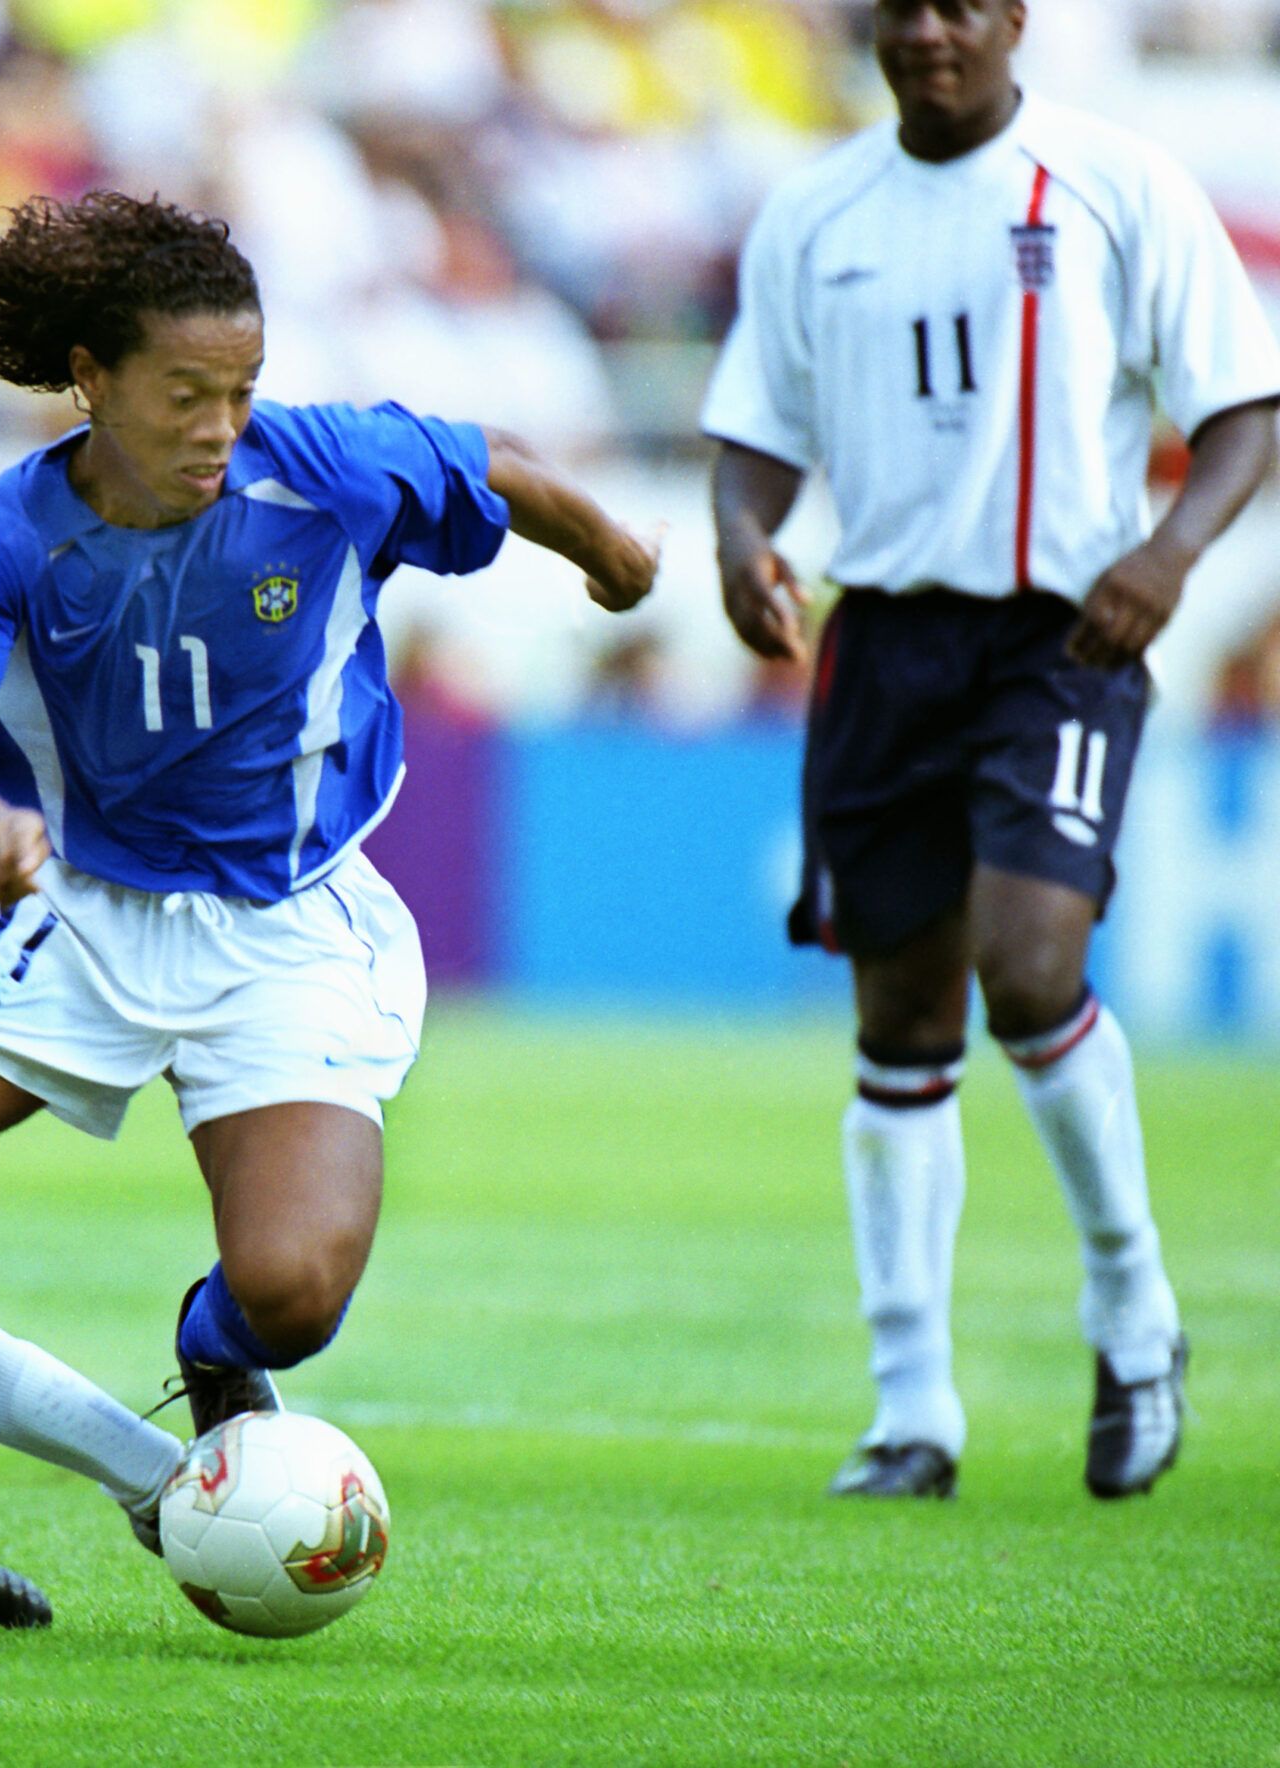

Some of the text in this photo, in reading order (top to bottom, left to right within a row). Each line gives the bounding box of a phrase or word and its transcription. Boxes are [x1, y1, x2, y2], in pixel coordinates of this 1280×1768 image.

[912, 315, 977, 397] 11
[135, 635, 213, 732] 11
[1048, 720, 1107, 823] 11
